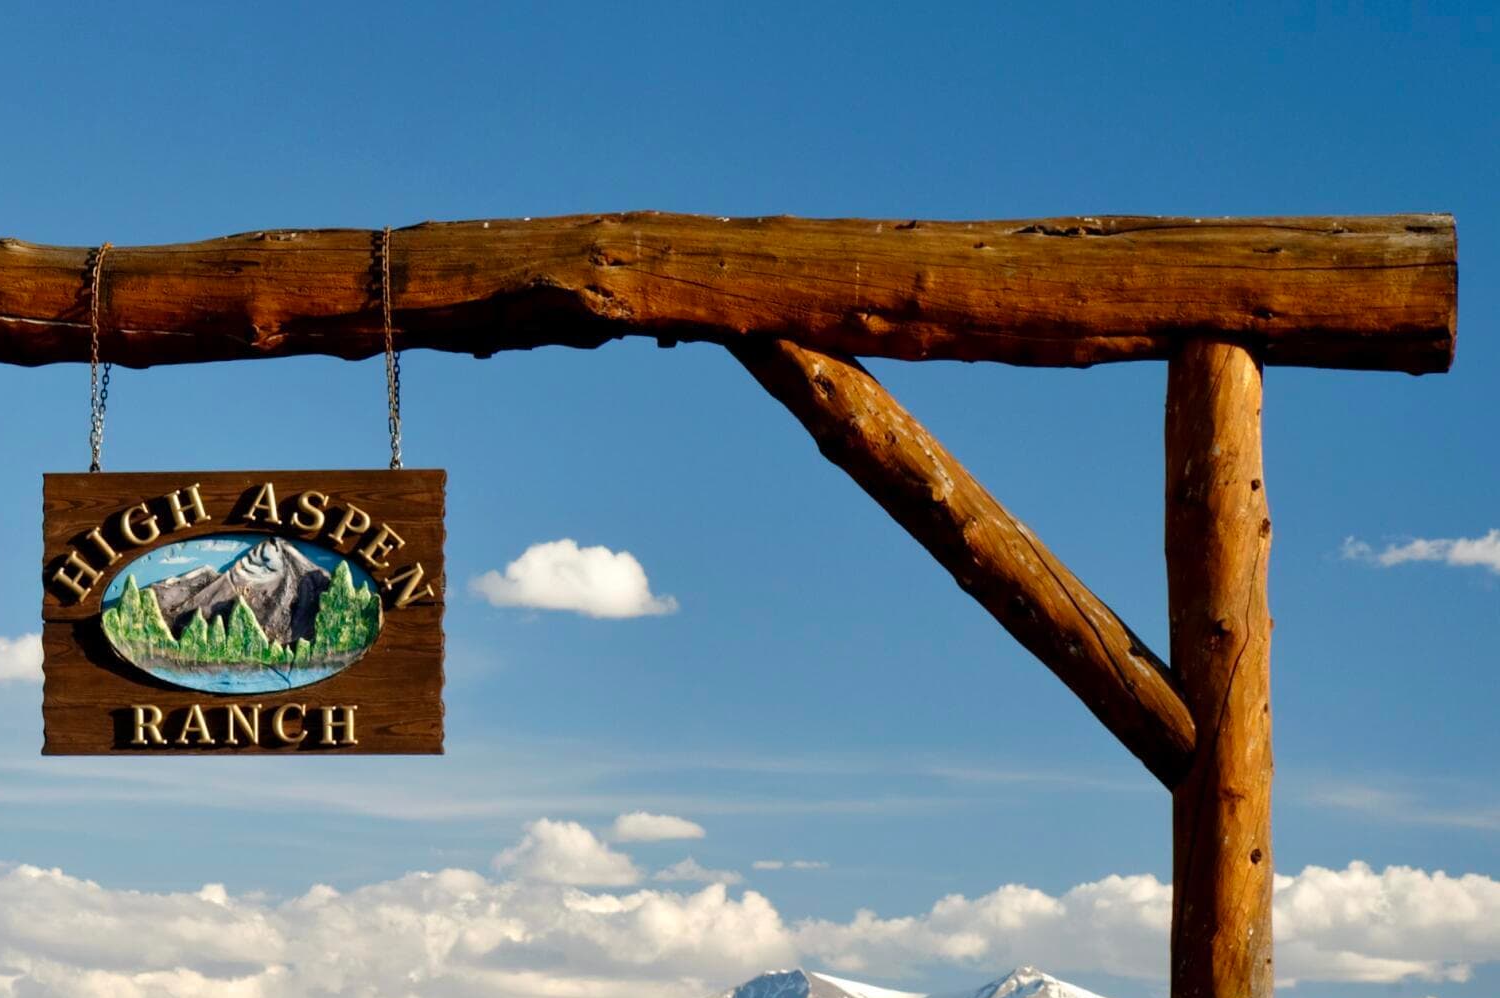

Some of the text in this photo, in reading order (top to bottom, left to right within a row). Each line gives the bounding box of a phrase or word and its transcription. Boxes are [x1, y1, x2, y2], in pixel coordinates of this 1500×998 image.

[52, 482, 436, 609] HIGH ASPEN
[130, 702, 359, 746] RANCH
